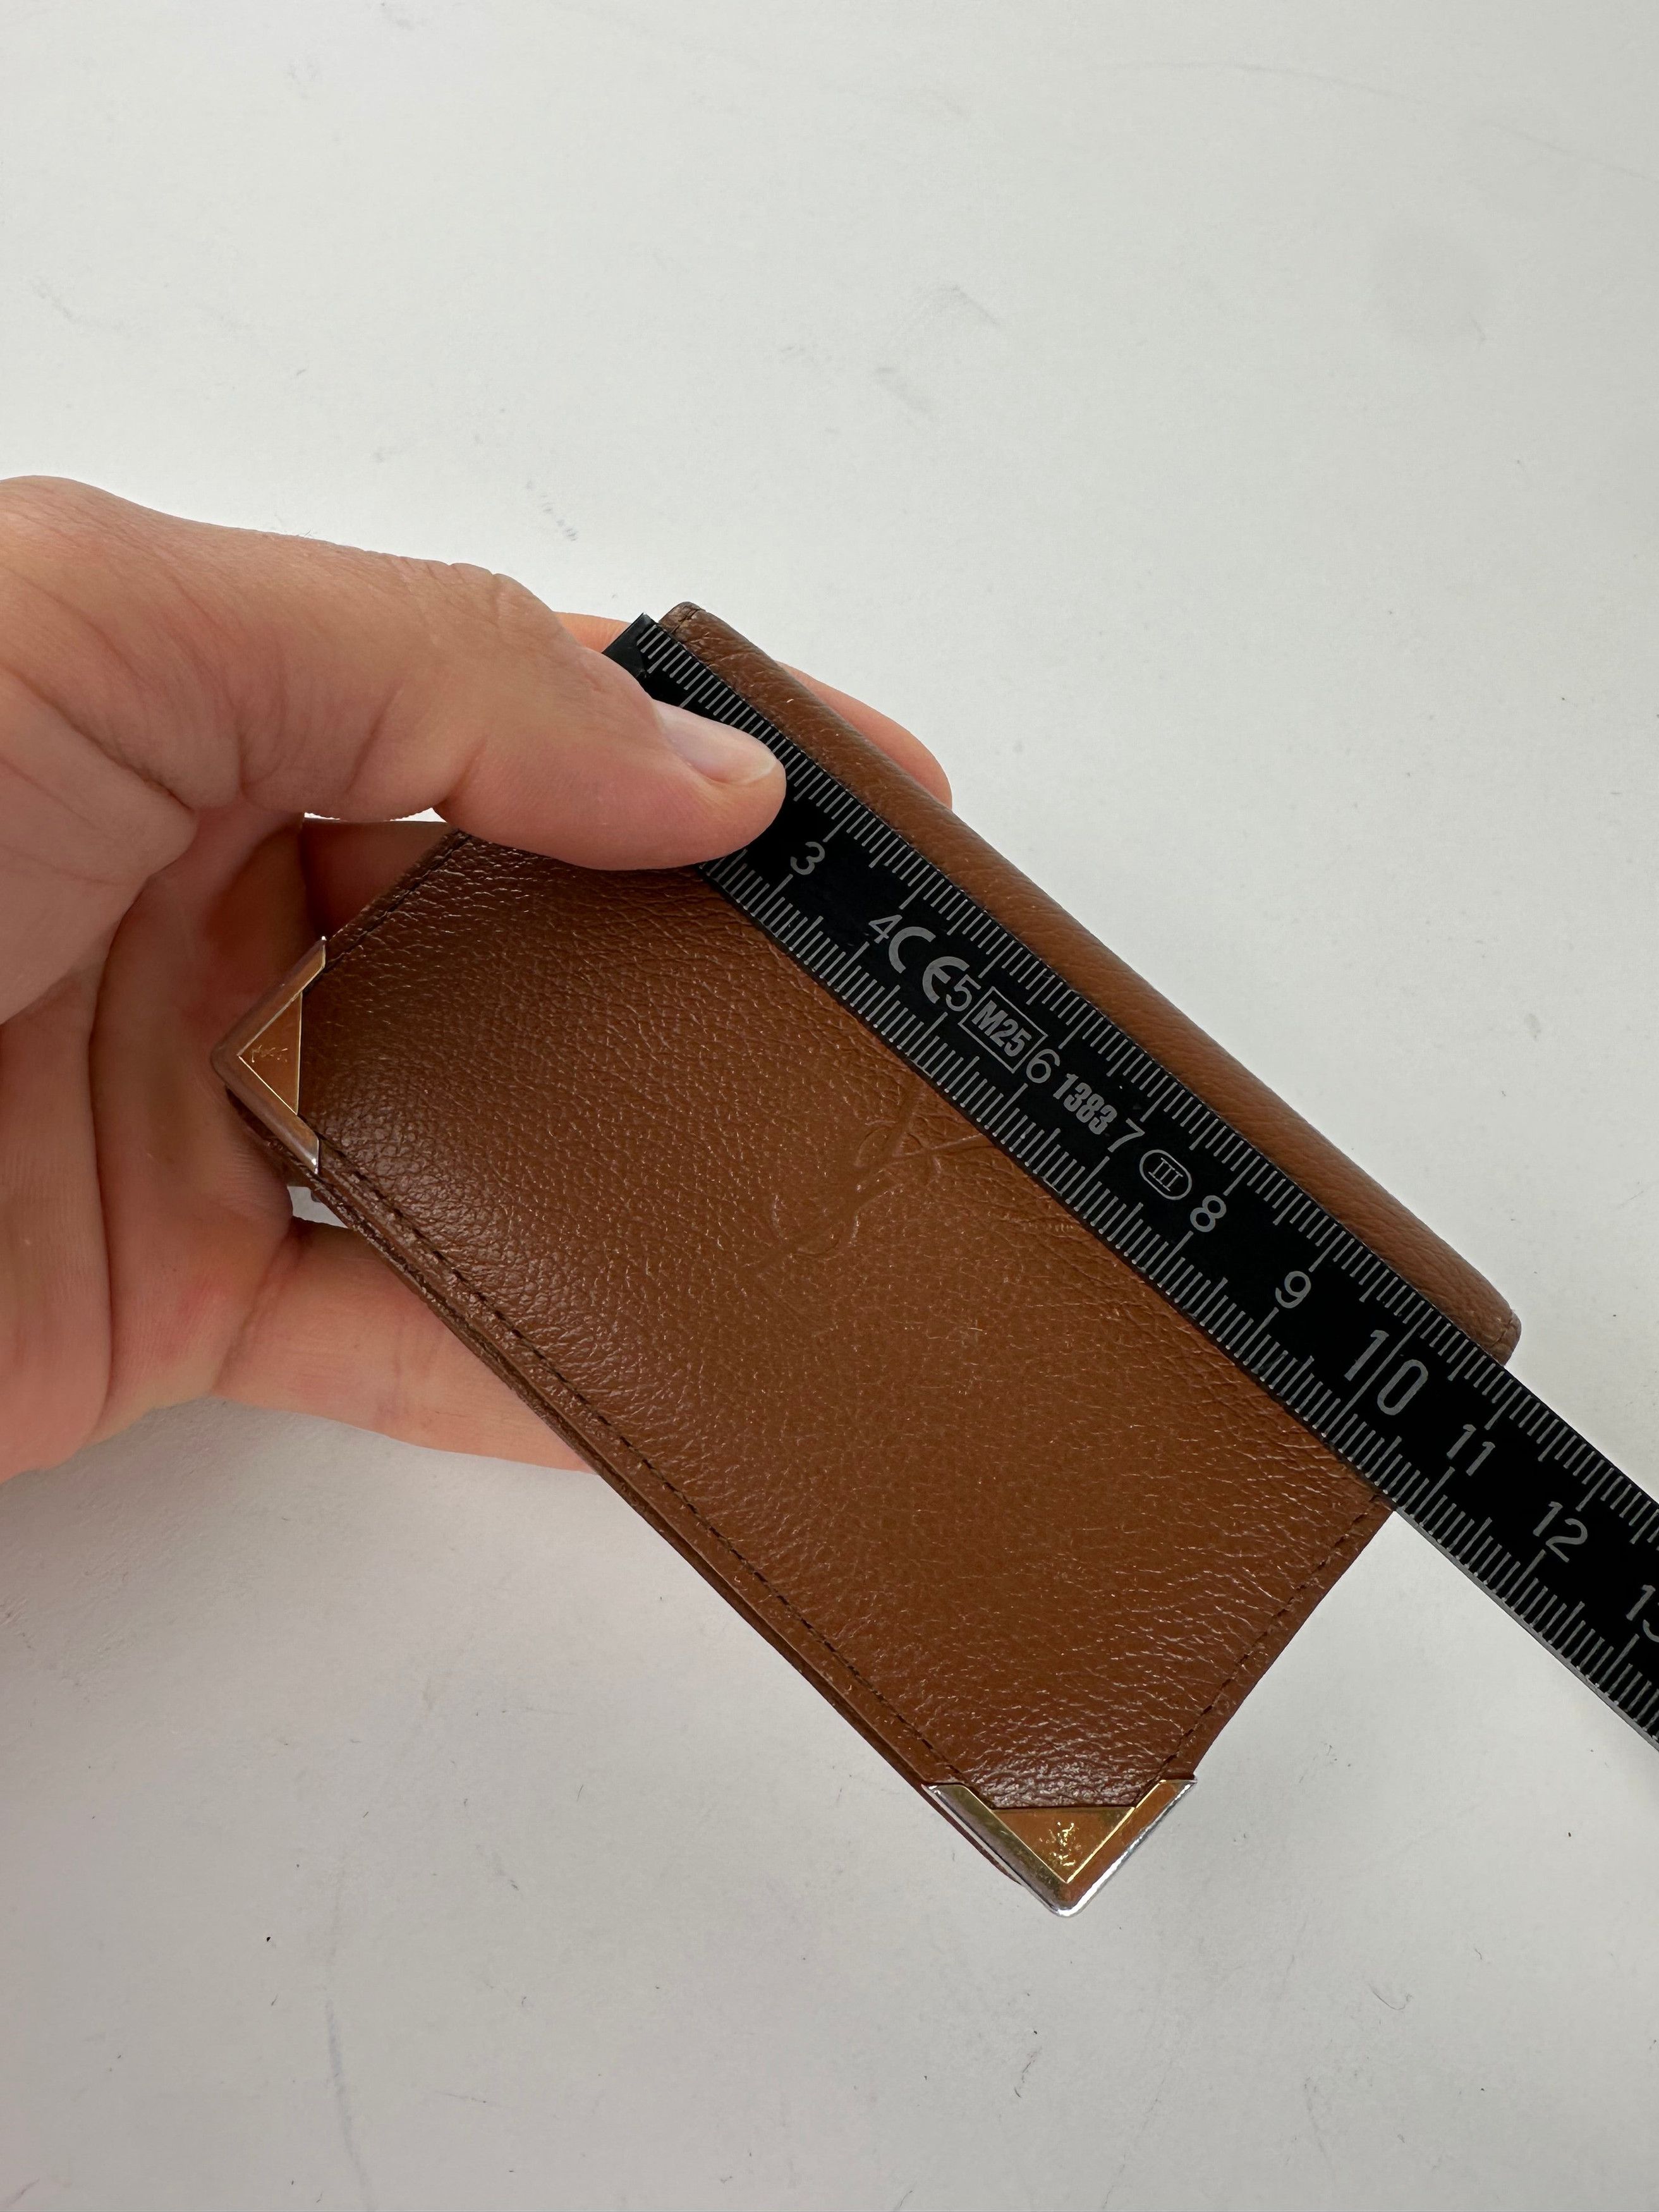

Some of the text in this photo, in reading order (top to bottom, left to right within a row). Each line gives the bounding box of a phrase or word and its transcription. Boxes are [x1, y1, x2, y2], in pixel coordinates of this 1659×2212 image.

[791, 841, 826, 876] 3
[868, 914, 902, 944] 4
[945, 975, 981, 1012] 5
[1025, 1048, 1061, 1085] 6
[1107, 1118, 1145, 1153] 7
[1189, 1194, 1227, 1233] 8
[1275, 1270, 1311, 1308] 9
[1344, 1329, 1429, 1415] 10
[1447, 1423, 1496, 1476] 11
[1533, 1501, 1588, 1562] 12
[887, 925, 971, 1004] CE
[972, 1000, 1032, 1058] M25
[1052, 1073, 1118, 1135] 1383
